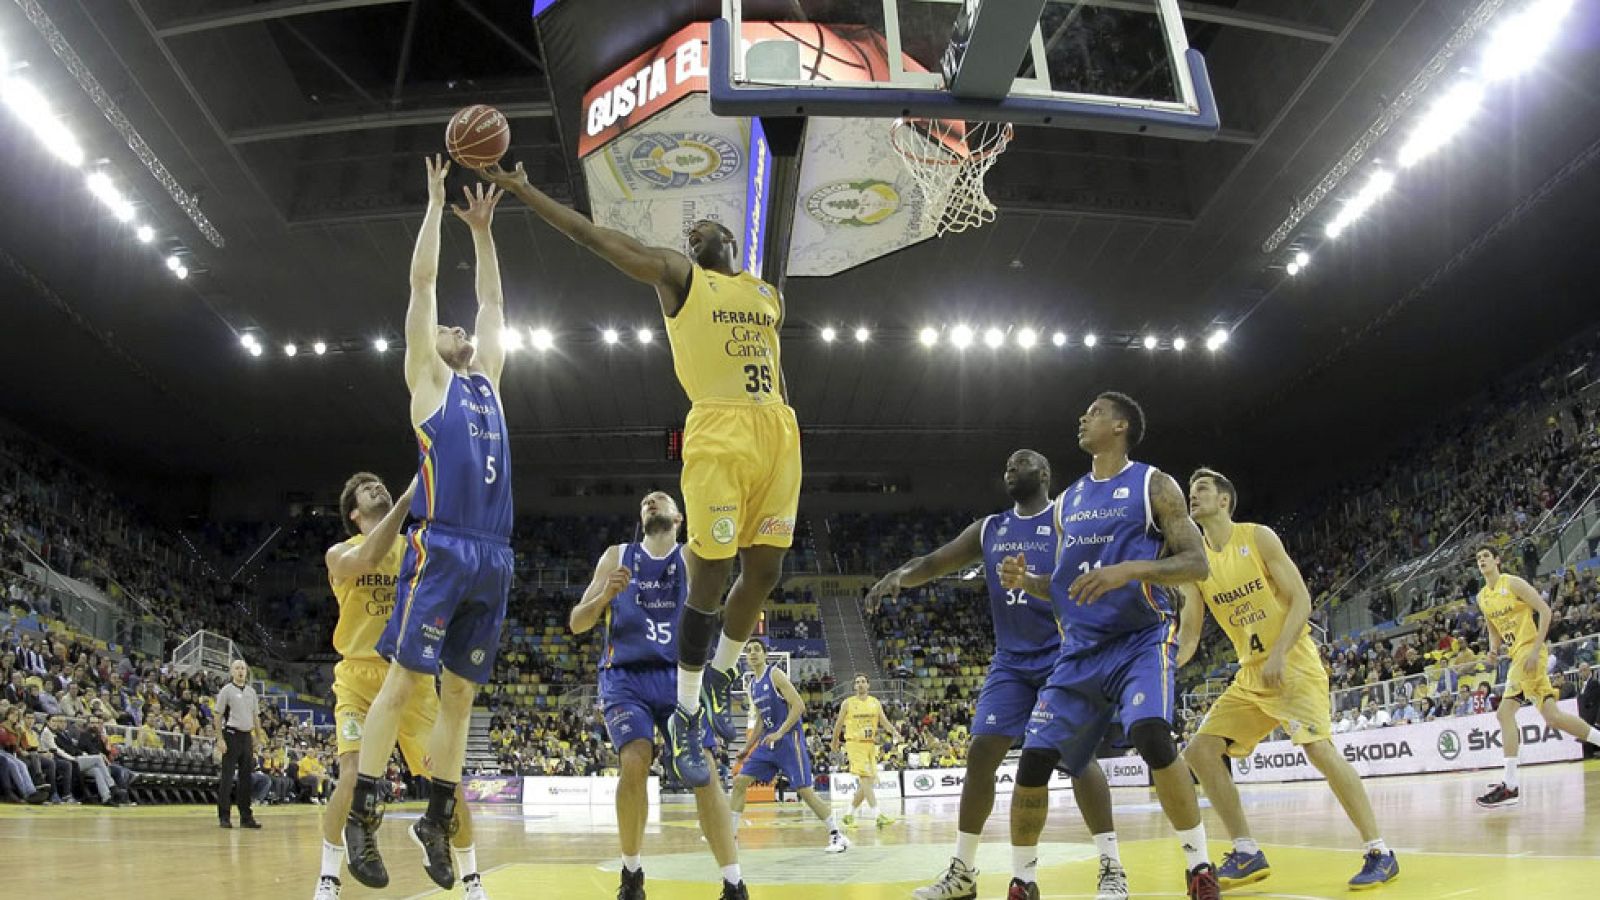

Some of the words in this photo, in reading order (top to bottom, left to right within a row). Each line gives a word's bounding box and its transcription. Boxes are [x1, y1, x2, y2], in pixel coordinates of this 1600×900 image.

[587, 57, 667, 136] GUSTA
[743, 364, 772, 392] 35
[485, 455, 497, 484] 5
[356, 574, 399, 587] HERBA
[646, 618, 672, 645] 35
[1250, 633, 1265, 656] 4
[1468, 724, 1563, 751] ŠKDA
[1254, 753, 1307, 769] ŠKODA
[1343, 740, 1412, 762] ŠKODA
[941, 773, 1013, 787] ŠKA
